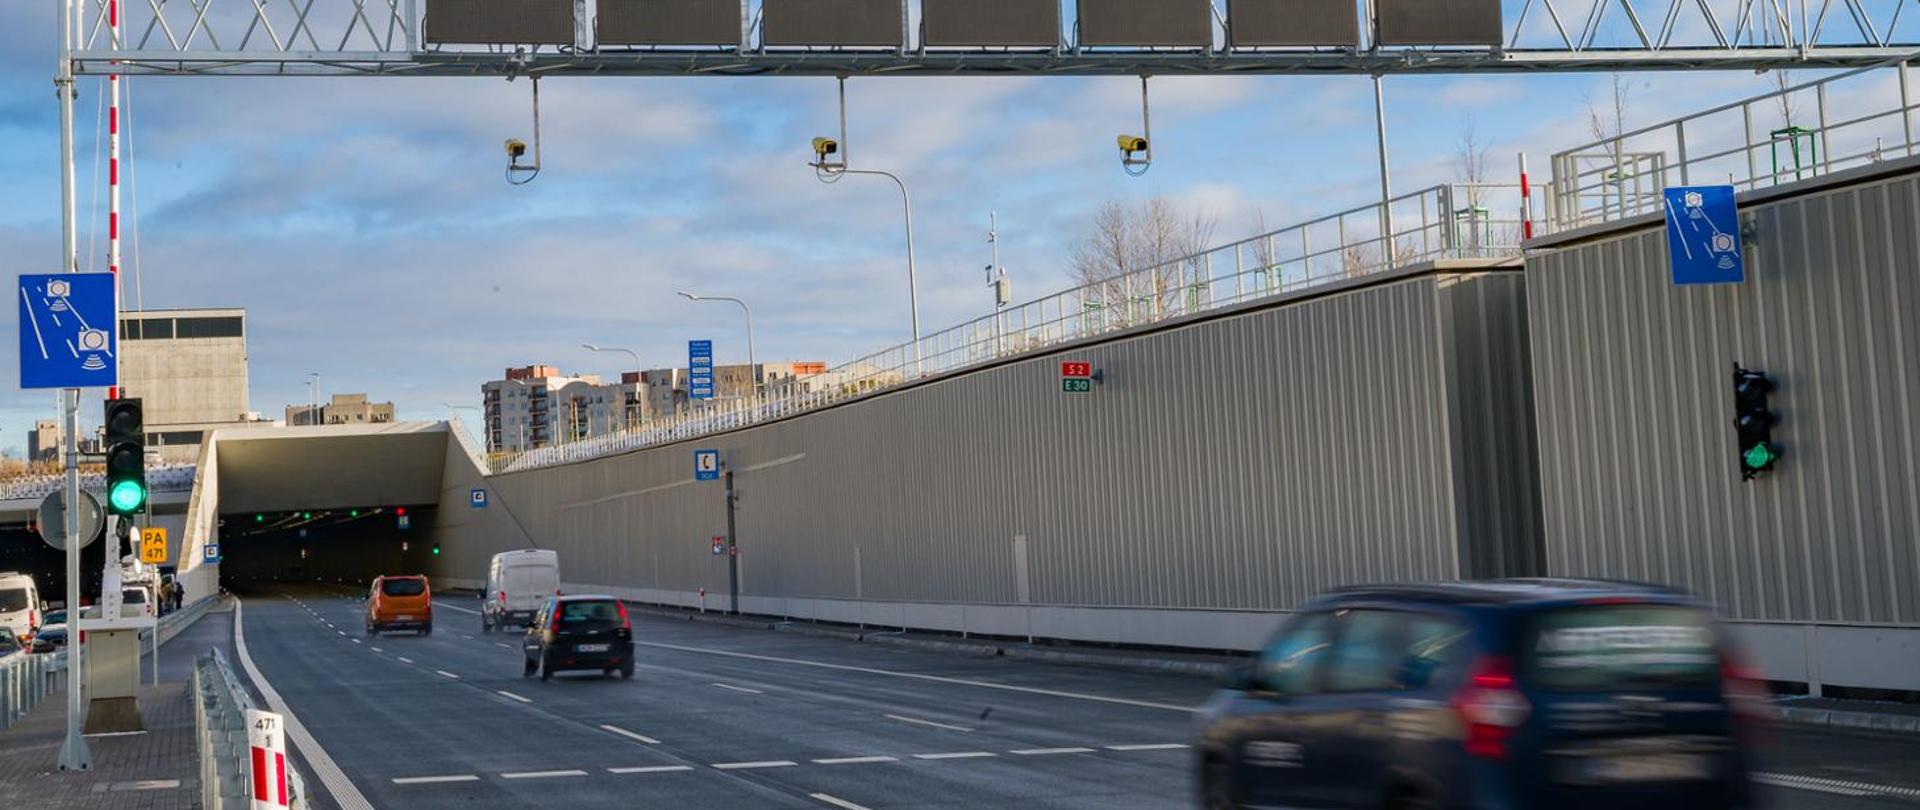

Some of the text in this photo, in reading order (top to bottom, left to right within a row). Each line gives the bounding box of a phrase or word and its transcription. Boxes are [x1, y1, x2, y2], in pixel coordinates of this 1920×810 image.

[1069, 364, 1085, 375] S 2
[1065, 380, 1088, 391] E 30
[144, 531, 164, 545] PA
[146, 548, 164, 558] 471
[255, 717, 275, 731] 471
[265, 735, 271, 748] 1
